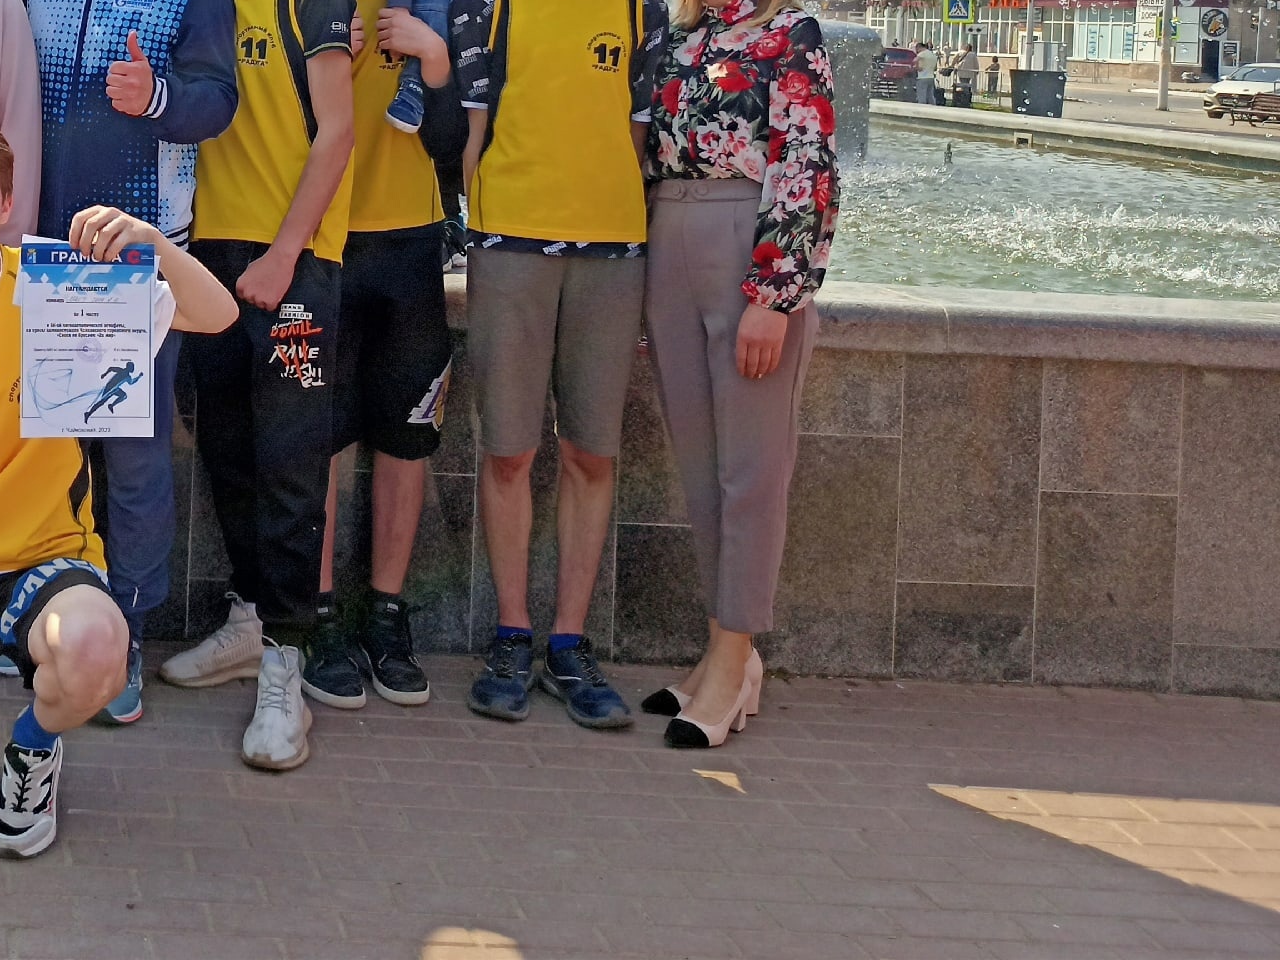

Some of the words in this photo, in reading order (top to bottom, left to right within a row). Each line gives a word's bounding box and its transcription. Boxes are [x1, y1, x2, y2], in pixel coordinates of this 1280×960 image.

[241, 36, 268, 60] 11
[594, 43, 621, 67] 11
[51, 251, 123, 263] ГРАМА
